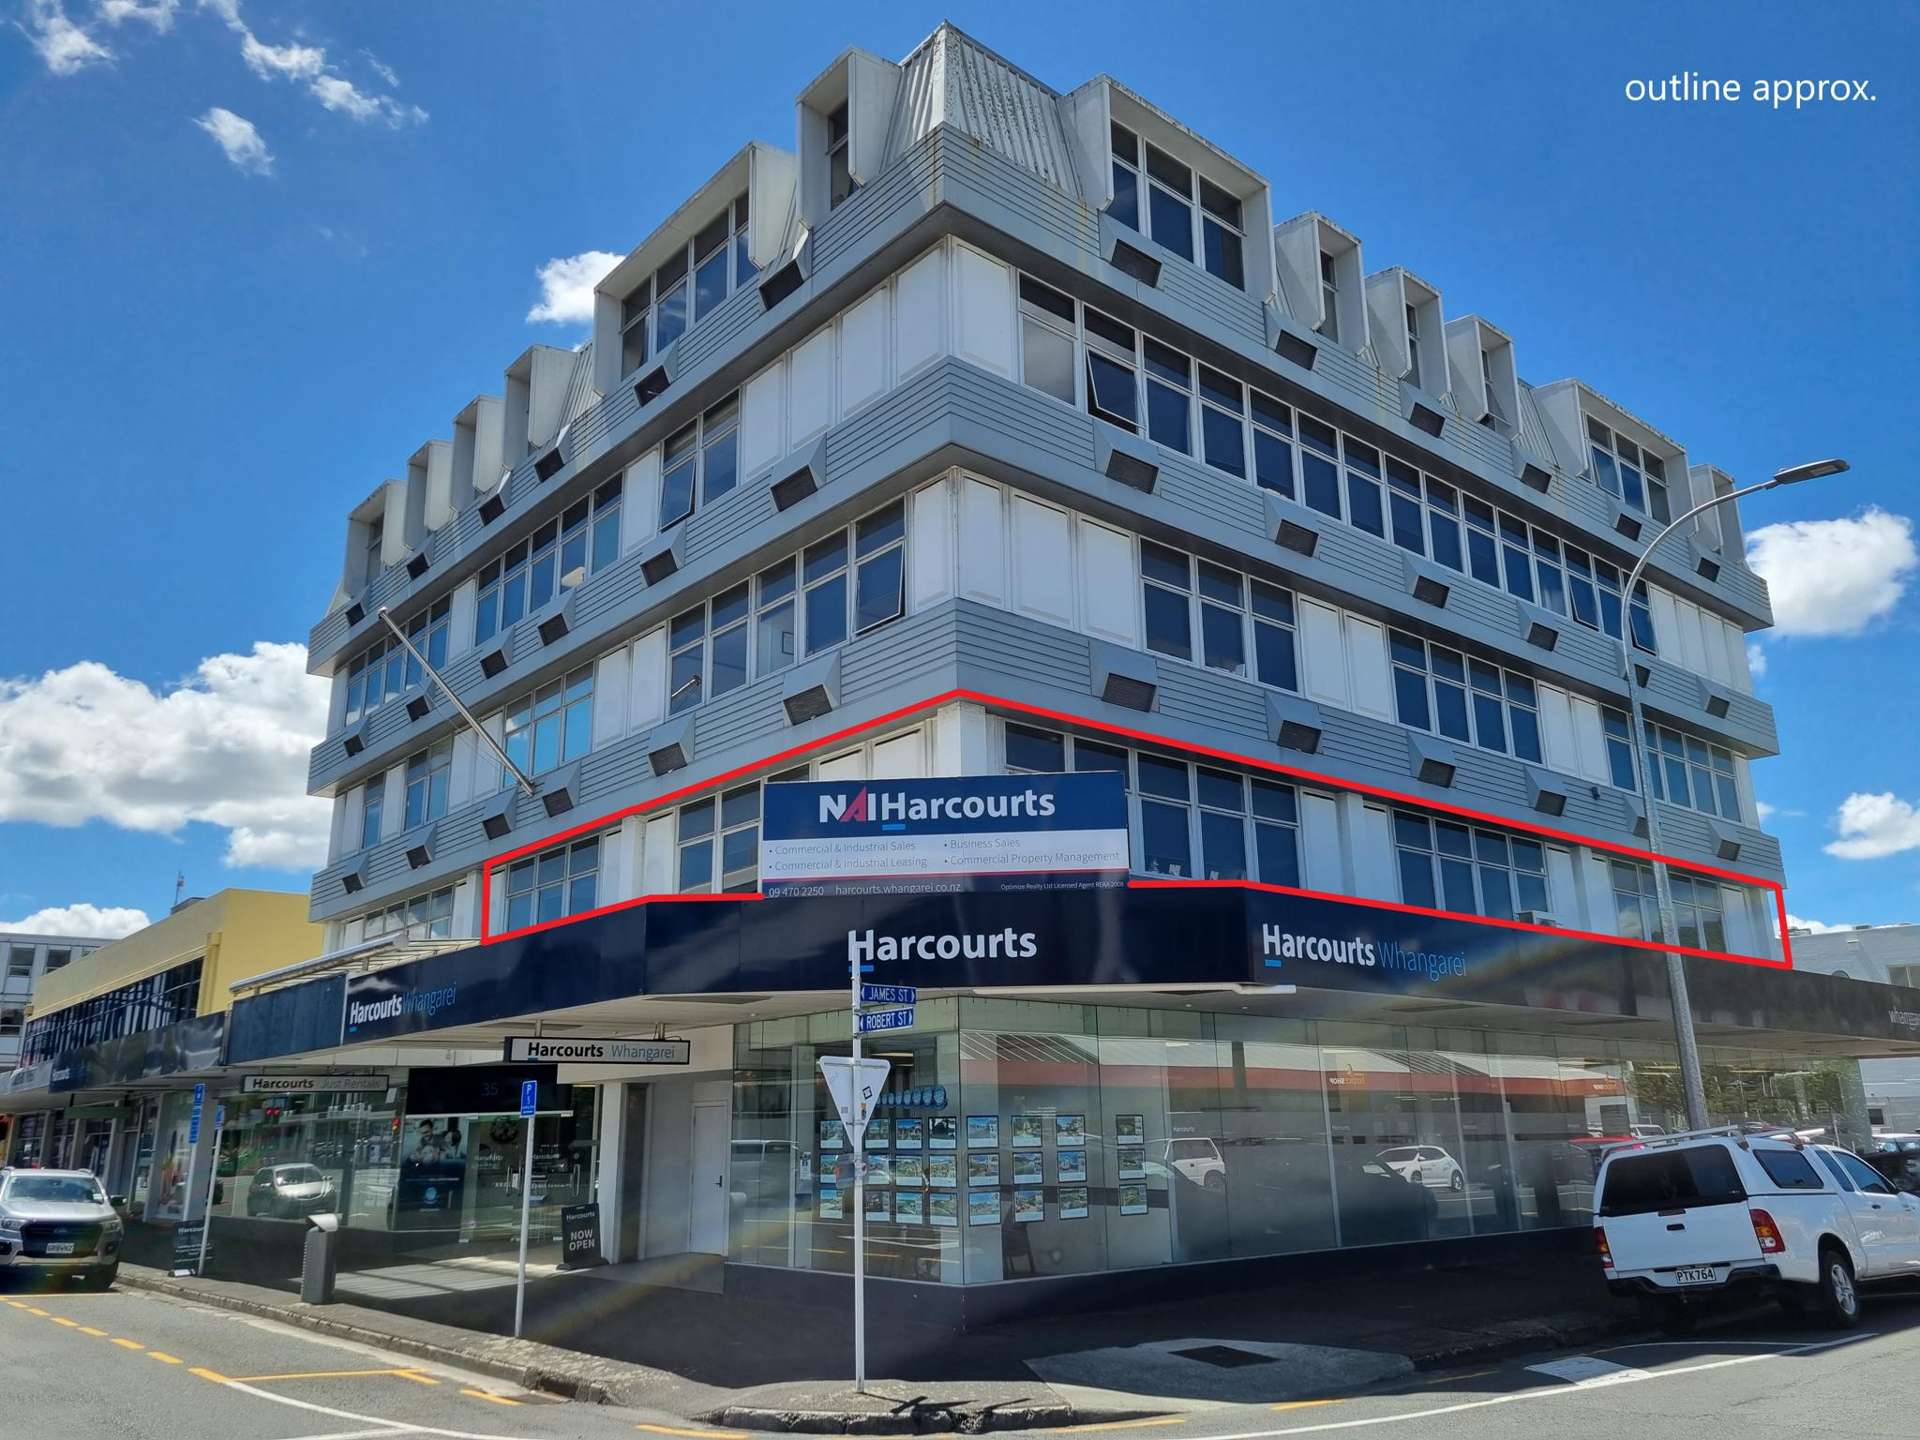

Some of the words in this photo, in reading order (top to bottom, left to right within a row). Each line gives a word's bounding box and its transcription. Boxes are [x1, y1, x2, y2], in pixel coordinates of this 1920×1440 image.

[881, 789, 1056, 820] Harcourts
[775, 843, 832, 855] Commercial
[844, 841, 887, 852] Industrial
[890, 840, 917, 851] Sales
[949, 838, 993, 849] Business
[995, 837, 1021, 848] Sales
[774, 858, 832, 871] Commercial
[844, 856, 887, 868] Industrial
[890, 856, 928, 869] Leasing
[950, 853, 1010, 866] Commercial
[1012, 852, 1053, 864] Property
[1055, 850, 1120, 864] Management
[768, 887, 781, 898] 09
[782, 886, 801, 897] 470
[802, 885, 824, 896] 2250
[835, 882, 961, 896] harcourts.whangarei.co.nz
[848, 928, 1038, 961] Harcourts
[1262, 923, 1376, 967] Harcourts
[1377, 940, 1466, 981] Whangarei
[868, 988, 895, 1001] JAMES
[898, 989, 908, 1001] ST
[349, 994, 402, 1024] Harcourts
[403, 981, 456, 1015] Whangarei
[866, 1014, 895, 1029] ROBERT
[897, 1012, 908, 1026] ST
[528, 1042, 604, 1057] Harcourts
[610, 1044, 675, 1061] Whangarei
[253, 1078, 314, 1089] Harcourts
[570, 1229, 593, 1241] NOW
[569, 1238, 595, 1251] OPEN
[1677, 1269, 1713, 1281] PTK764
